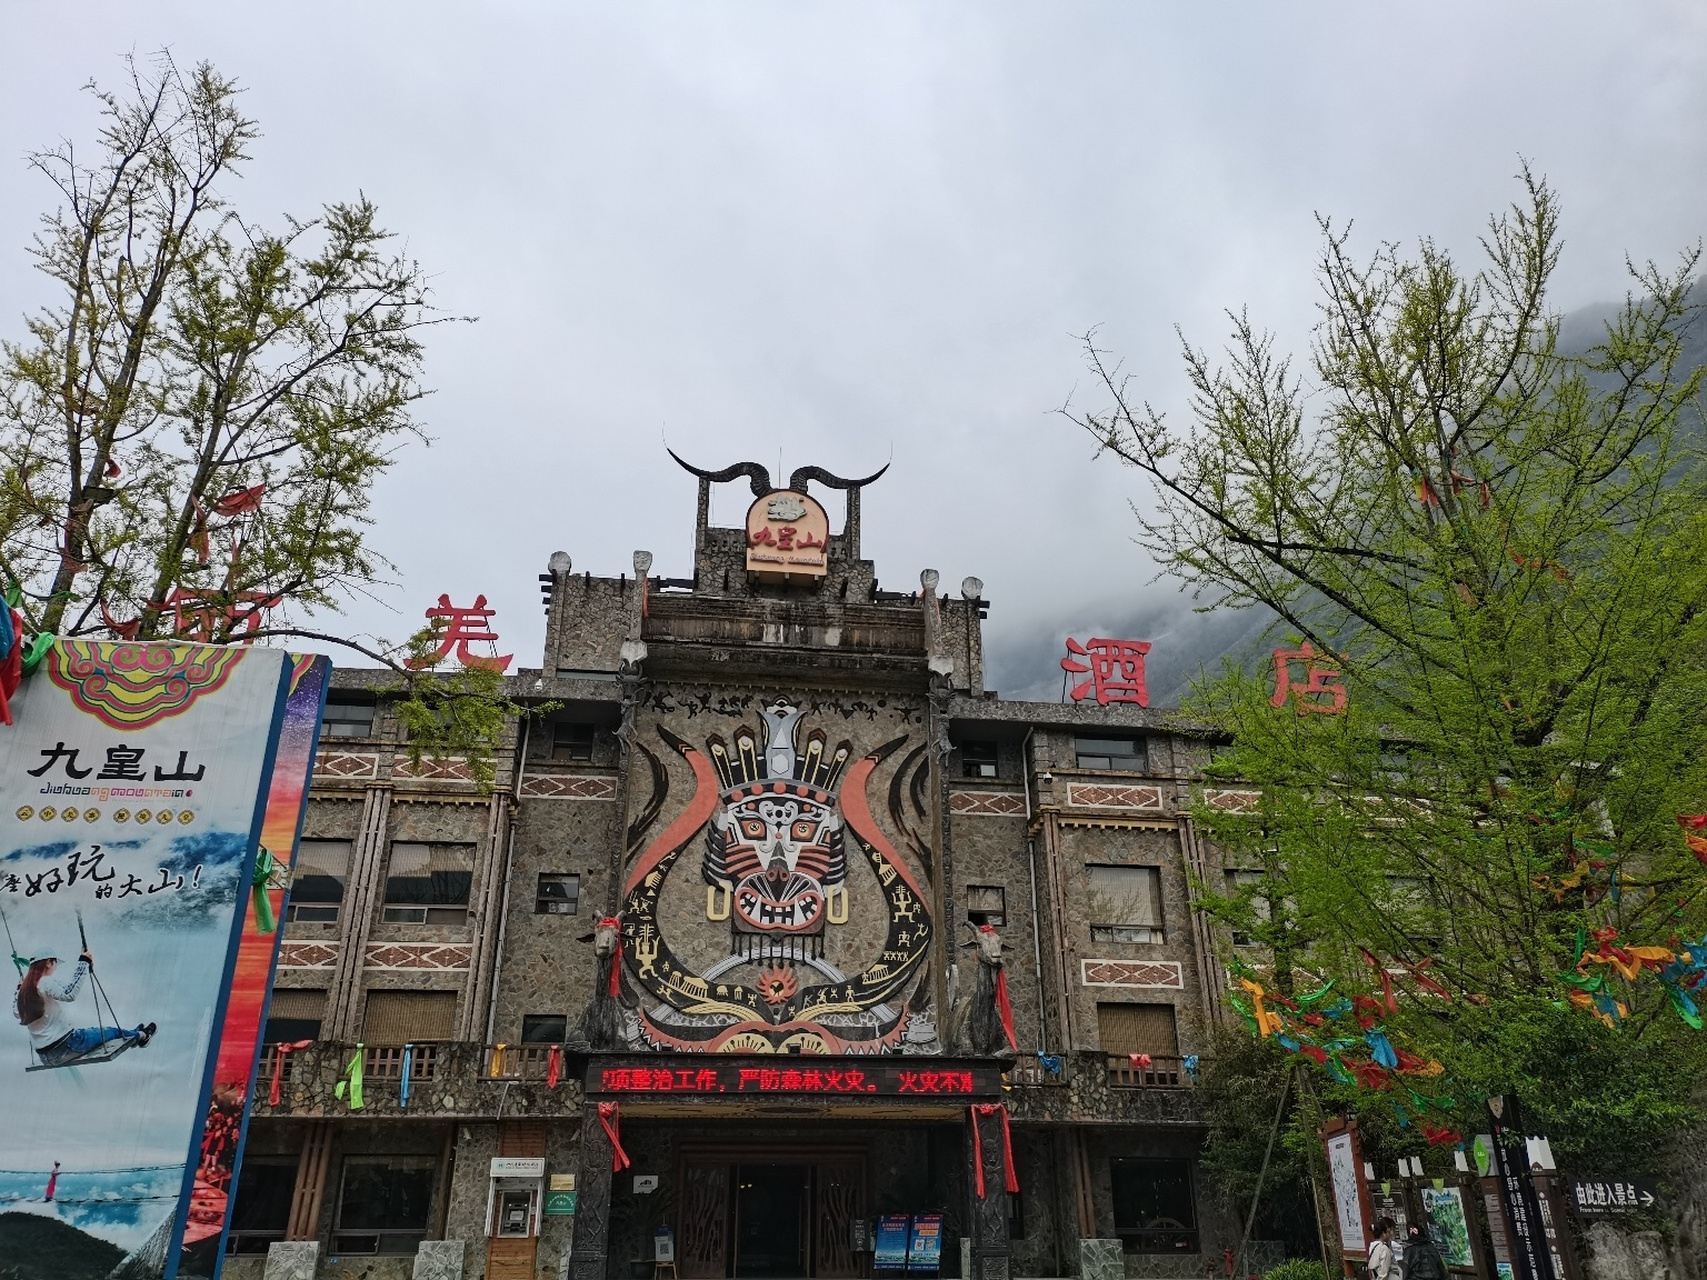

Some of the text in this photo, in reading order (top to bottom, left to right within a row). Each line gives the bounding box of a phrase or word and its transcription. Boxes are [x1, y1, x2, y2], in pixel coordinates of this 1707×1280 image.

[751, 525, 822, 551] 九皇山
[1060, 637, 1152, 708] 酒
[1269, 641, 1349, 716] 店
[27, 741, 206, 782] 九皇山
[1575, 1182, 1638, 1206] 由此进入景点
